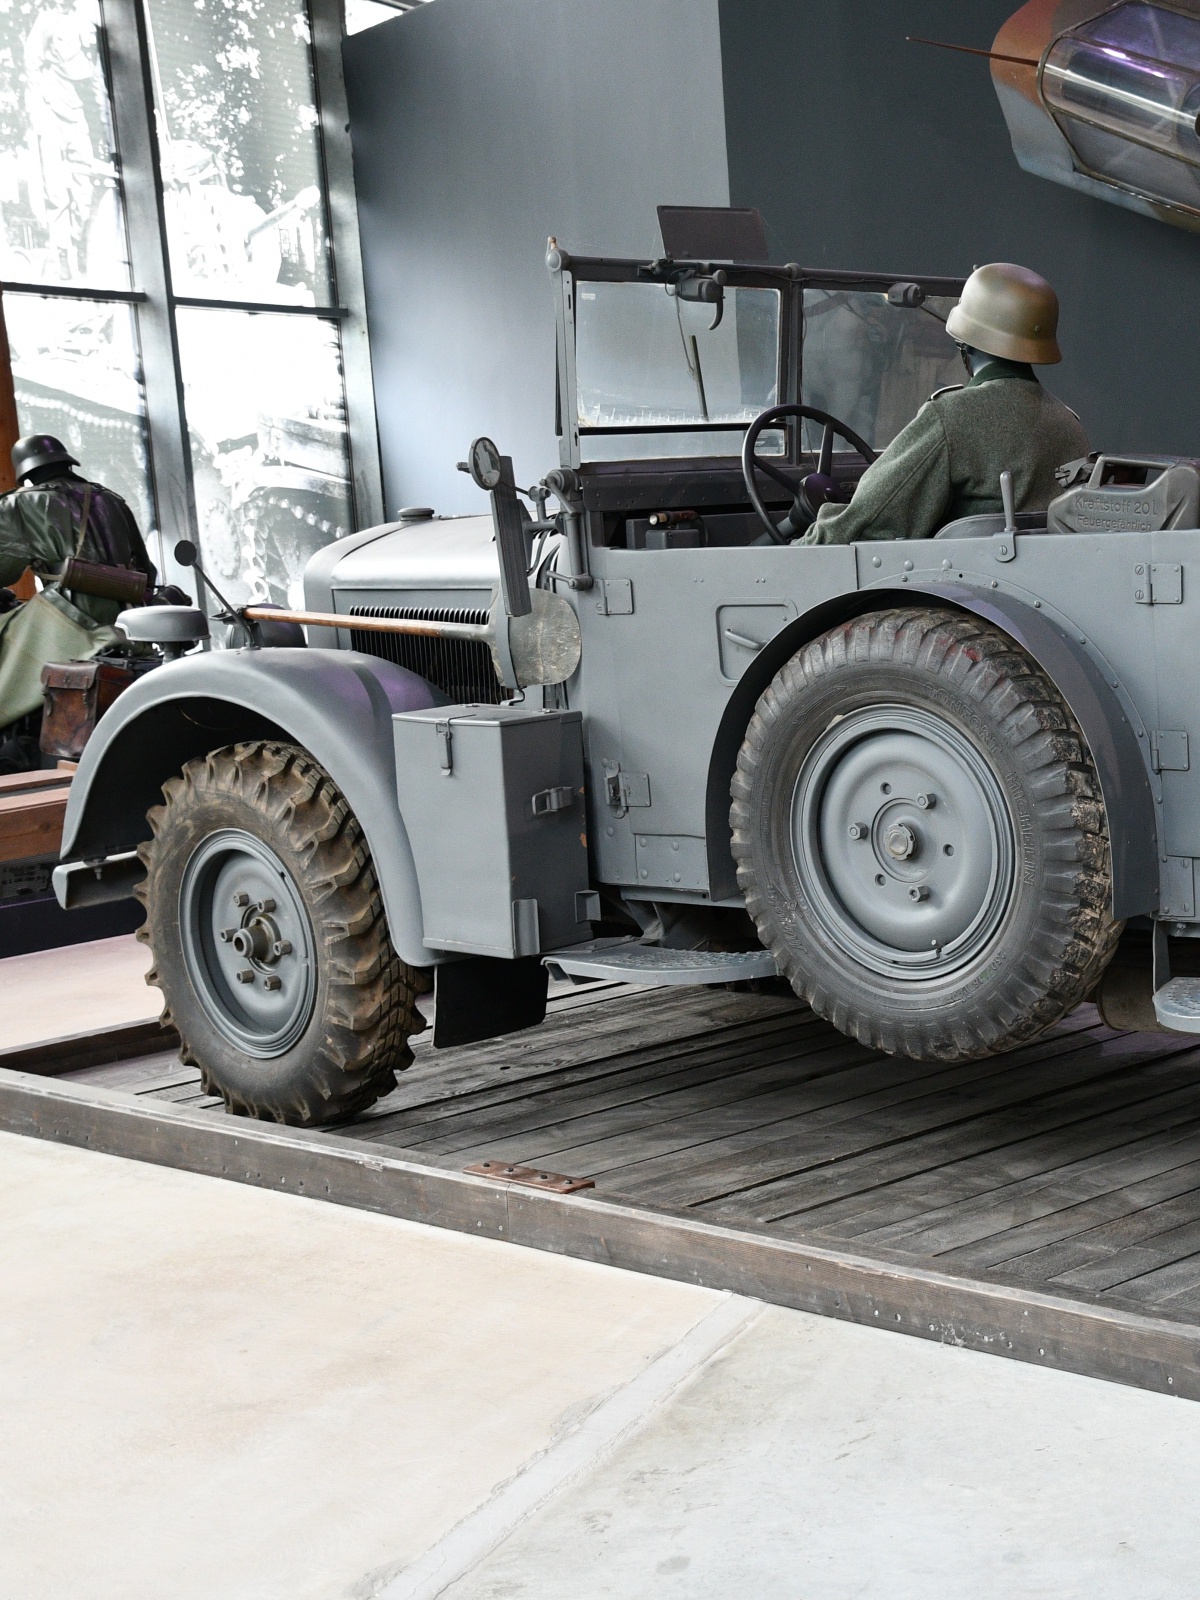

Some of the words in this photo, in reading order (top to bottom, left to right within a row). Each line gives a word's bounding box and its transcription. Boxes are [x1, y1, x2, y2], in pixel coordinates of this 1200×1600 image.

[1075, 495, 1130, 515] Kraftstoff
[1133, 501, 1150, 516] 20
[1077, 514, 1151, 532] Feuergefährlich
[1006, 771, 1036, 887] MICHELIN
